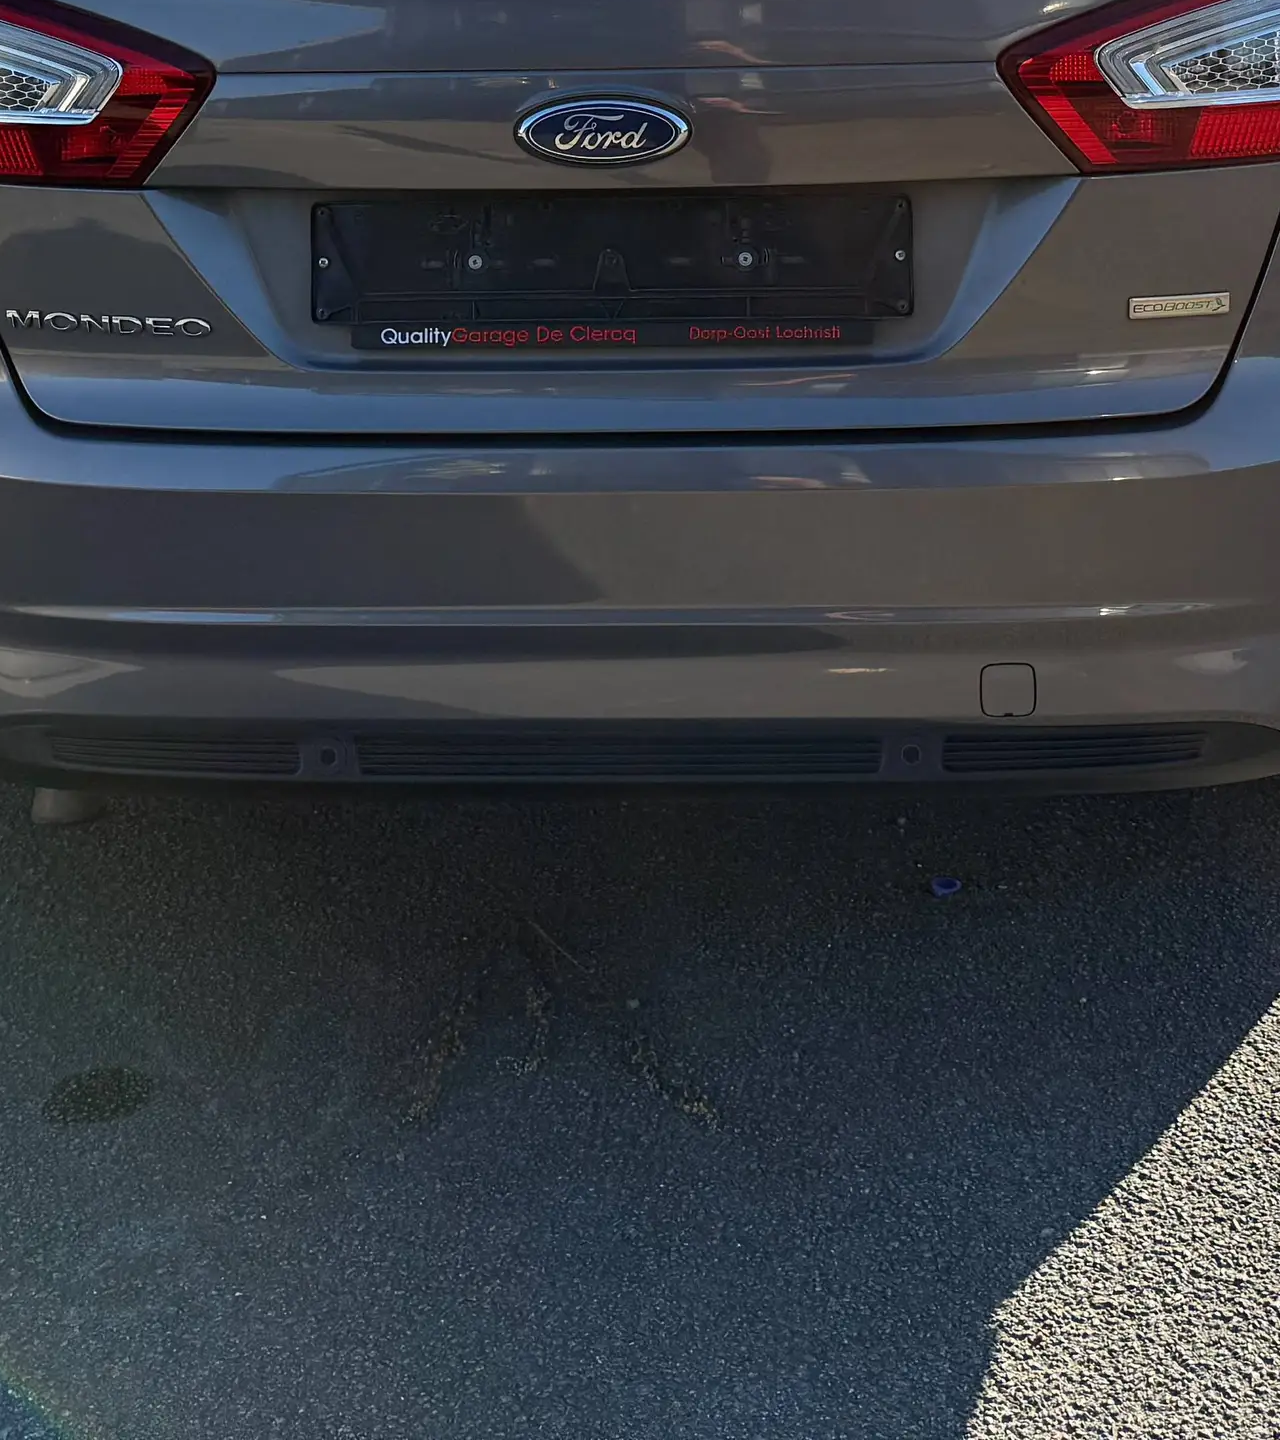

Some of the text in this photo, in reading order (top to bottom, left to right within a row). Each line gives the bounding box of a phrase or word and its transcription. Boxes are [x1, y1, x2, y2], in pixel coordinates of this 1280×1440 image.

[554, 113, 648, 150] Ford
[1133, 300, 1214, 314] ECOBOOST
[6, 310, 211, 336] MONDEO
[537, 326, 563, 343] De
[570, 325, 637, 344] Clercq
